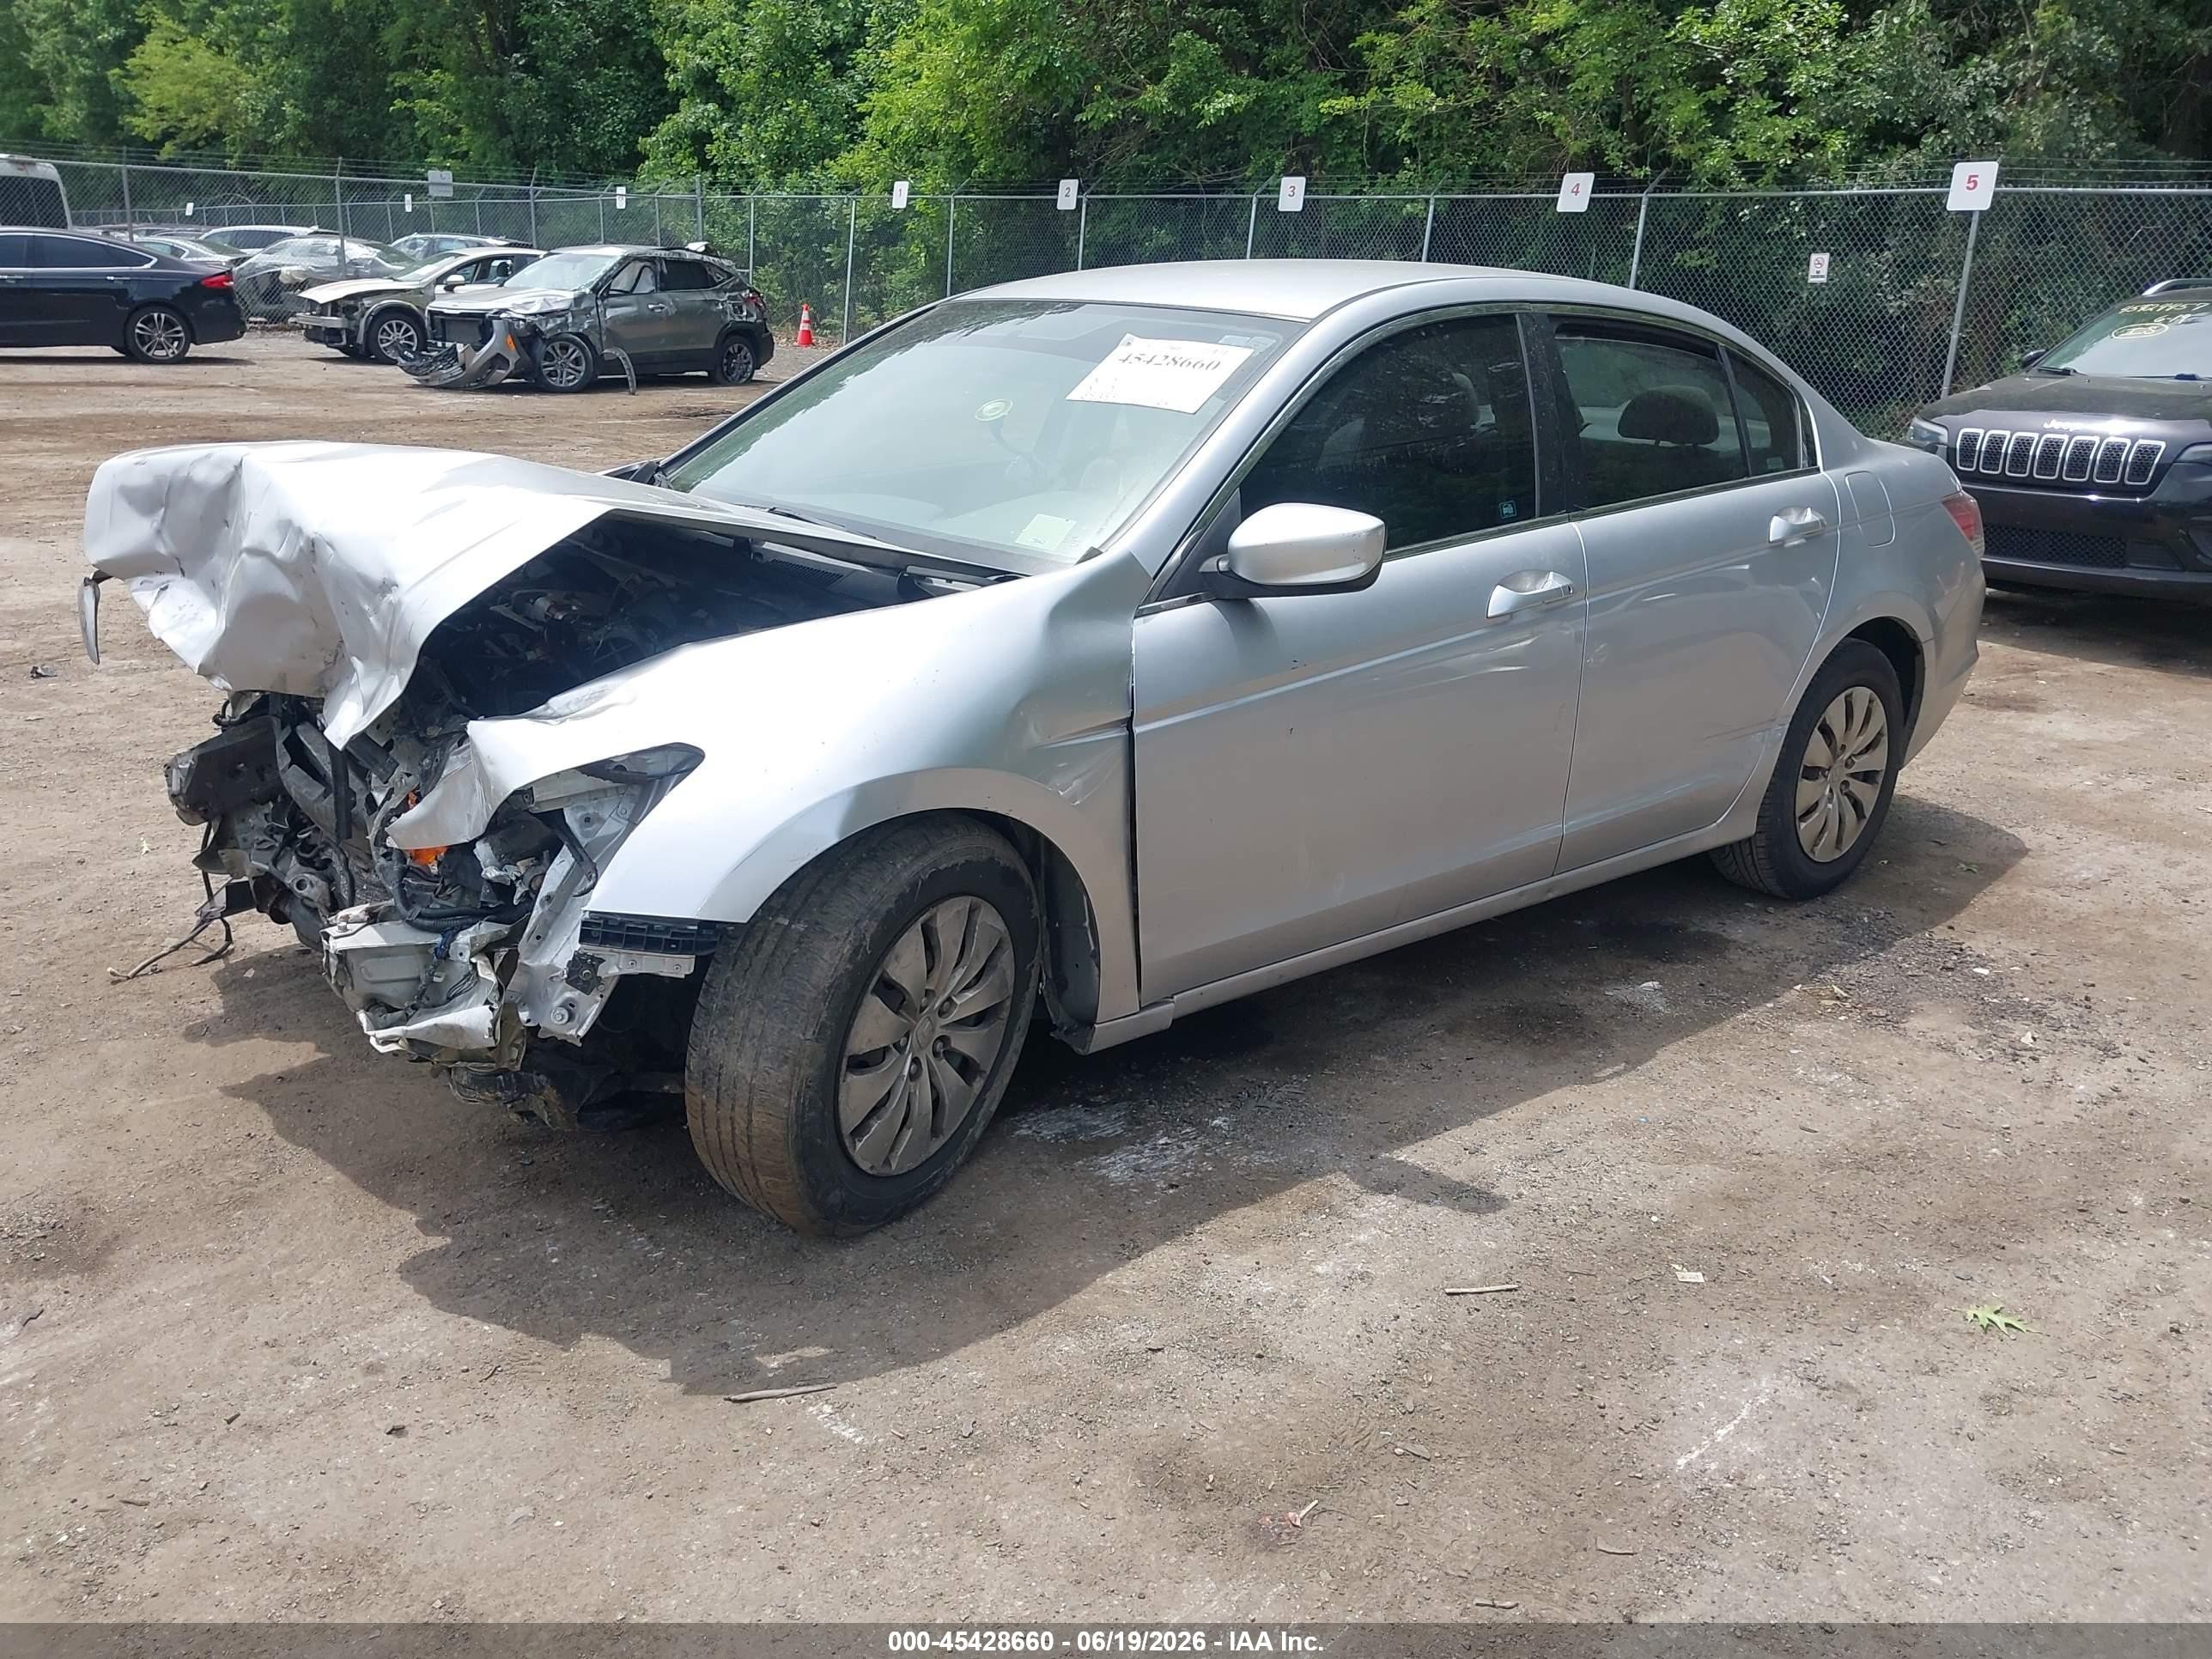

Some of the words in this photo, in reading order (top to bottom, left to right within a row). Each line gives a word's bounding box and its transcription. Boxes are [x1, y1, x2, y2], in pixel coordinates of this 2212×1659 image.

[1966, 174, 1979, 191] 5
[1064, 186, 1071, 198] 2
[1288, 185, 1296, 198] 3
[1571, 183, 1581, 197] 4
[1118, 352, 1221, 371] 45428660
